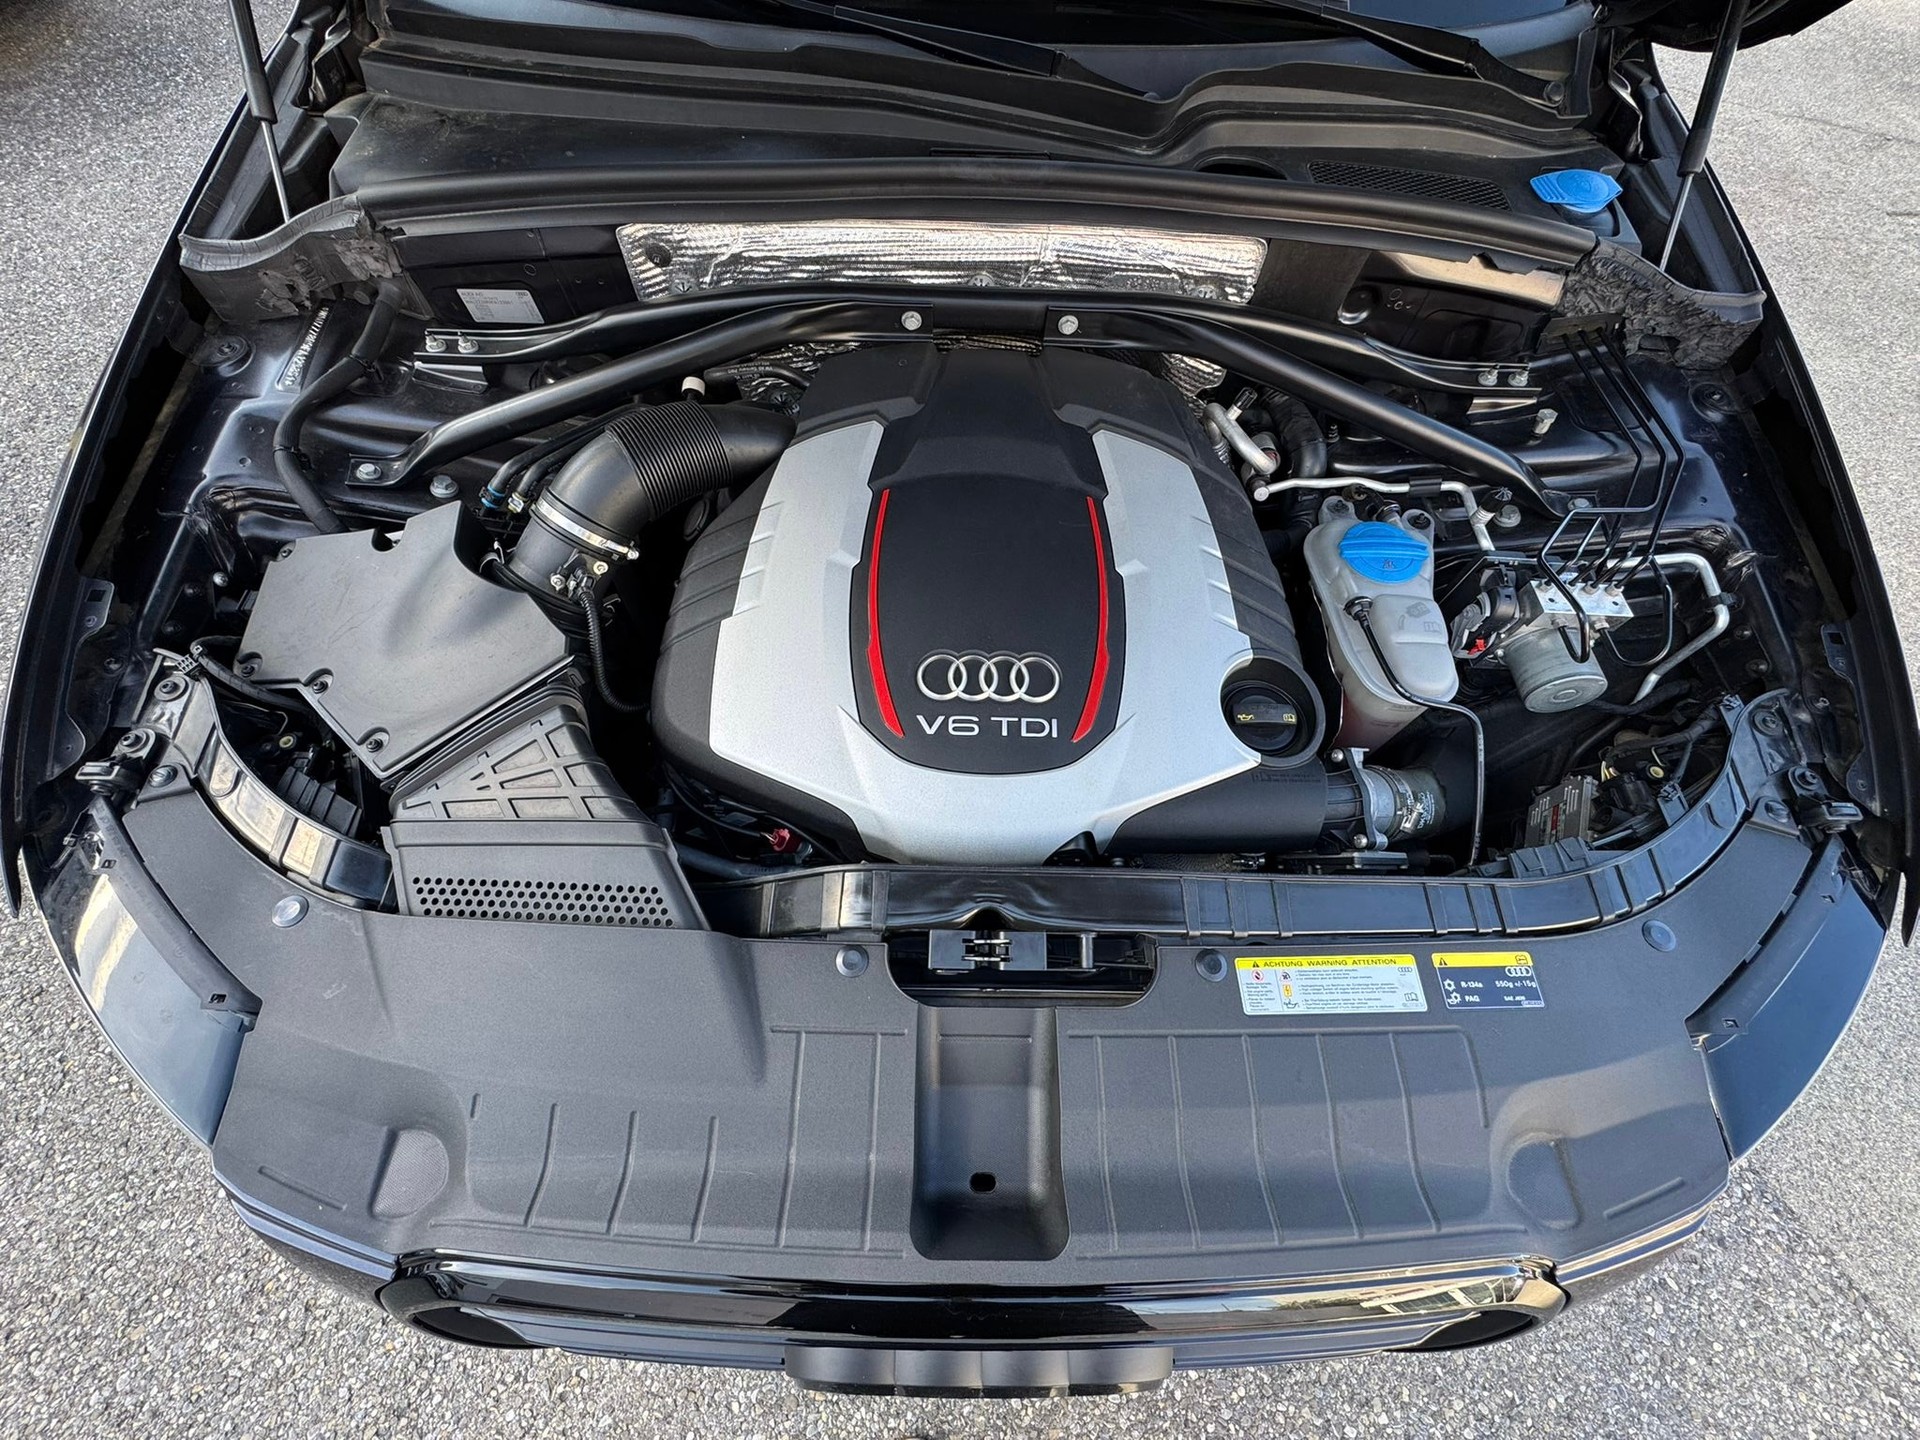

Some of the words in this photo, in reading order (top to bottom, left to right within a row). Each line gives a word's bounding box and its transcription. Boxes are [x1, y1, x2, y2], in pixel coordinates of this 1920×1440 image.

[916, 714, 980, 736] V6
[990, 716, 1058, 738] TDI
[1263, 960, 1303, 968] ACHTUNG
[1307, 959, 1348, 967] WARNING
[1352, 958, 1397, 966] ATTENTION
[1495, 980, 1513, 988] 550g
